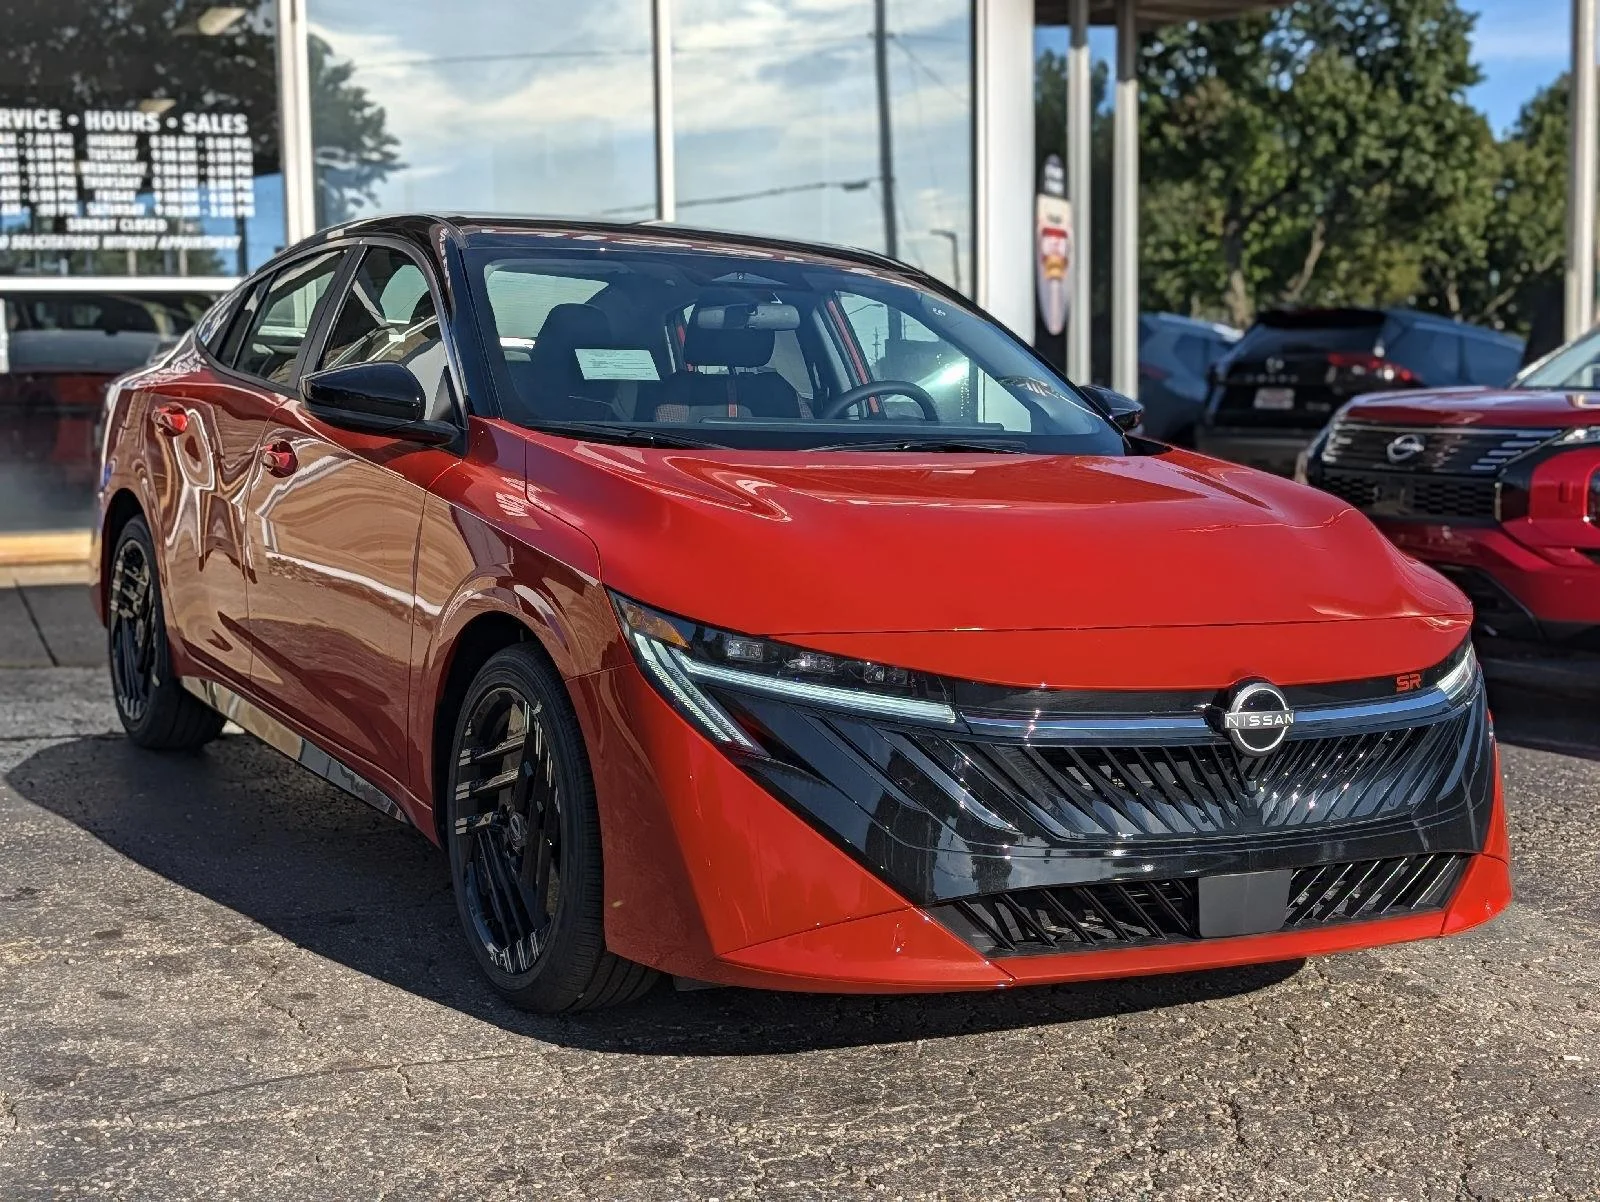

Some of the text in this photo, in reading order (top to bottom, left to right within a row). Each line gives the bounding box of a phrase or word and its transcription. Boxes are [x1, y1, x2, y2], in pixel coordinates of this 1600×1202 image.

[0, 108, 248, 134] RVICE HOURS SALES
[66, 218, 168, 231] SUNDAY CLOSED
[1395, 673, 1422, 692] SR
[1226, 712, 1294, 728] NISSAN
